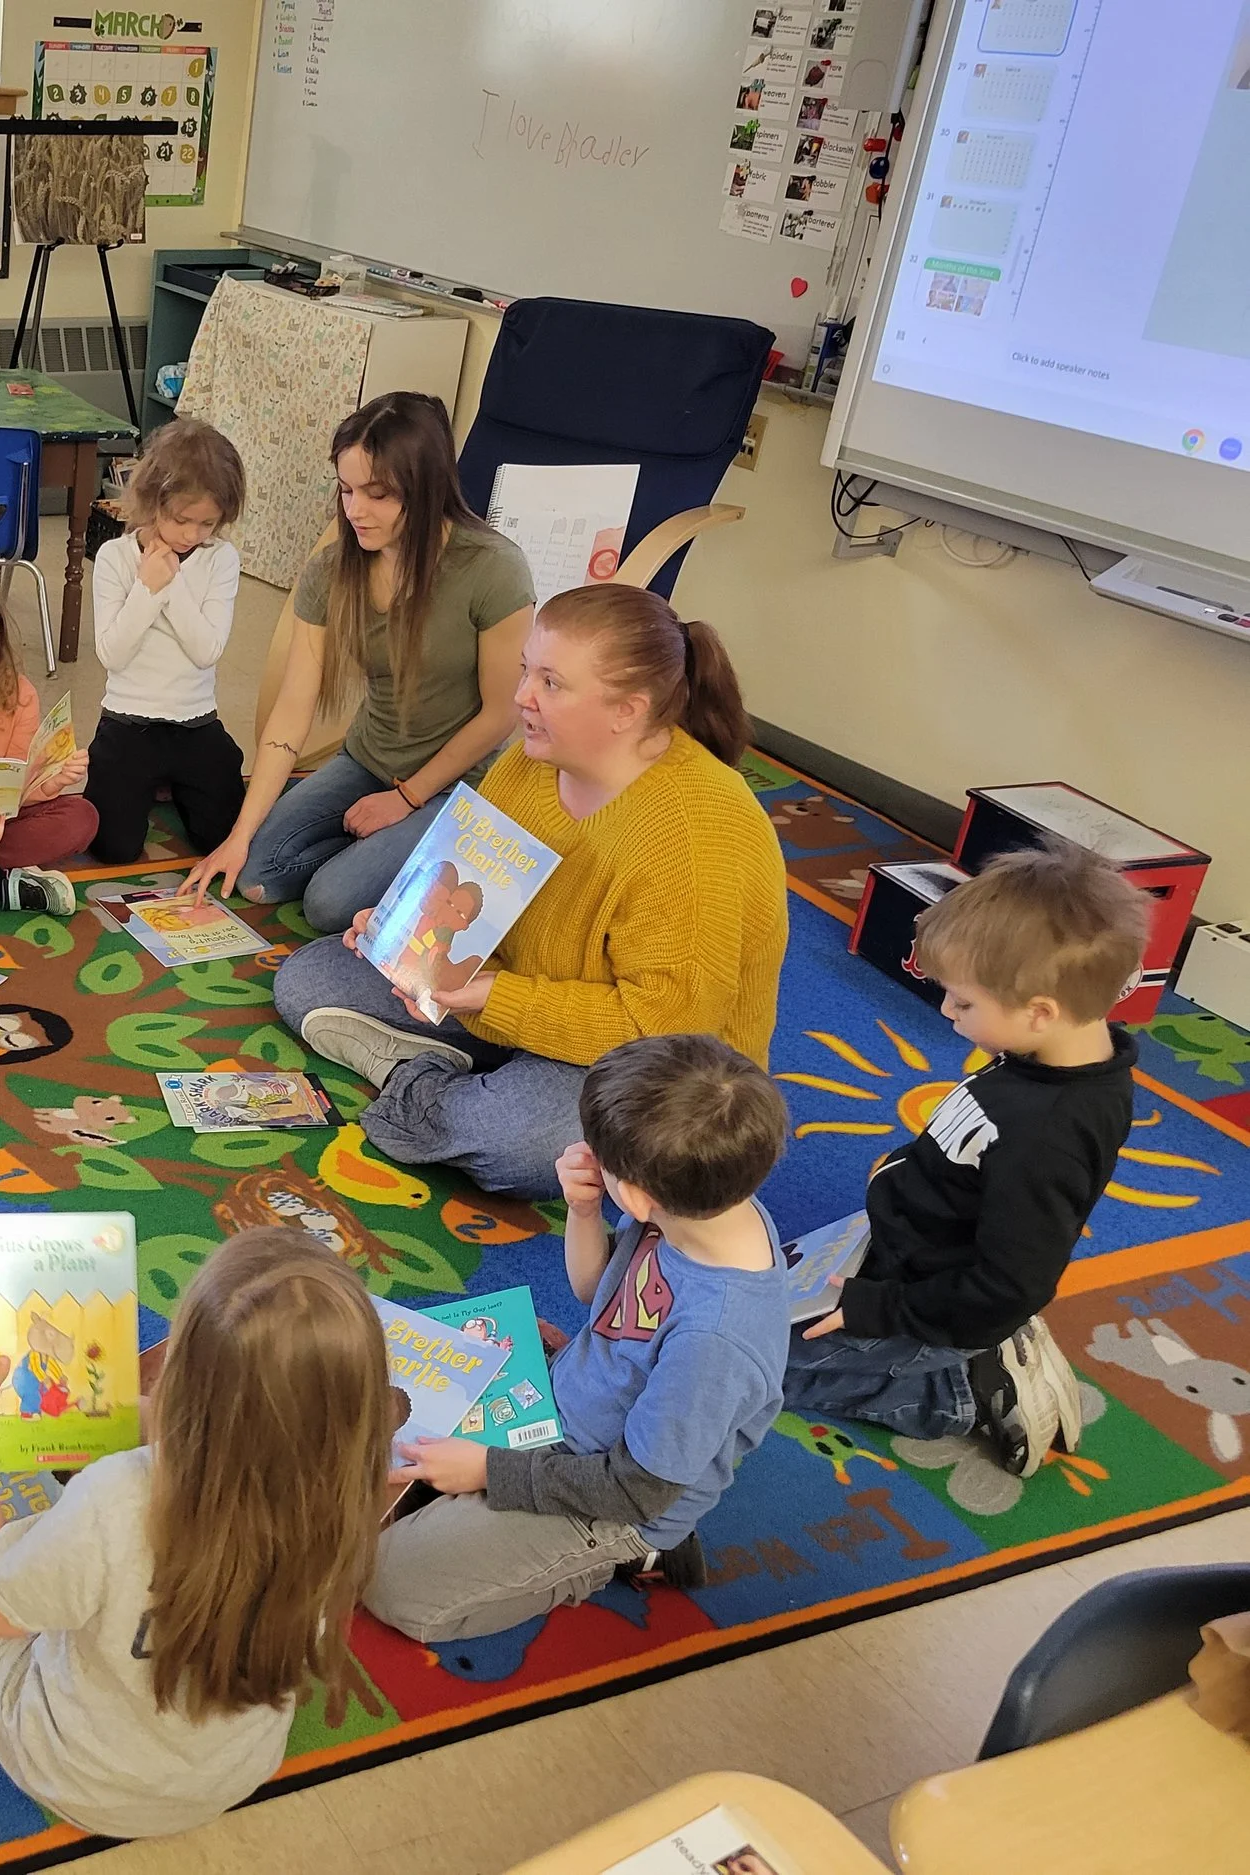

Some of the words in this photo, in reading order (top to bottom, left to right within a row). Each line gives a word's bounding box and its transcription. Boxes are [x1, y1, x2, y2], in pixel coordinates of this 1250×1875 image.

[95, 9, 169, 38] MARCH
[770, 52, 793, 62] spindles
[53, 90, 59, 100] 2
[75, 90, 82, 101] 3
[99, 90, 106, 100] 4
[121, 90, 127, 100] 5
[146, 91, 152, 102] 6
[167, 90, 173, 101] 7
[190, 91, 196, 102] 8
[185, 122, 194, 133] 15
[507, 100, 551, 150] love
[756, 131, 780, 140] spinners
[160, 145, 170, 157] 21
[182, 148, 194, 159] 22
[823, 143, 854, 155] blacksmith
[749, 169, 767, 181] fabric
[813, 179, 837, 189] cobbler
[745, 210, 770, 222] patterns
[1012, 351, 1029, 362] Click
[1030, 356, 1039, 365] to
[1040, 359, 1055, 369] add
[1056, 360, 1087, 375] speaker
[1087, 368, 1111, 380] notes
[451, 796, 476, 831] My
[472, 816, 538, 876] Brother
[454, 833, 515, 891] Charlie
[188, 933, 238, 945] Biscuit's
[189, 1074, 219, 1098] SHARK
[193, 1101, 234, 1124] CLARK
[456, 1214, 497, 1240] 2
[28, 1236, 86, 1253] Grows
[34, 1261, 44, 1273] a
[48, 1254, 98, 1273] Plant
[461, 1310, 471, 1318] Fly
[473, 1306, 486, 1314] Guy
[384, 1318, 484, 1375] Brother
[20, 1445, 29, 1453] by
[31, 1443, 54, 1452] Frank
